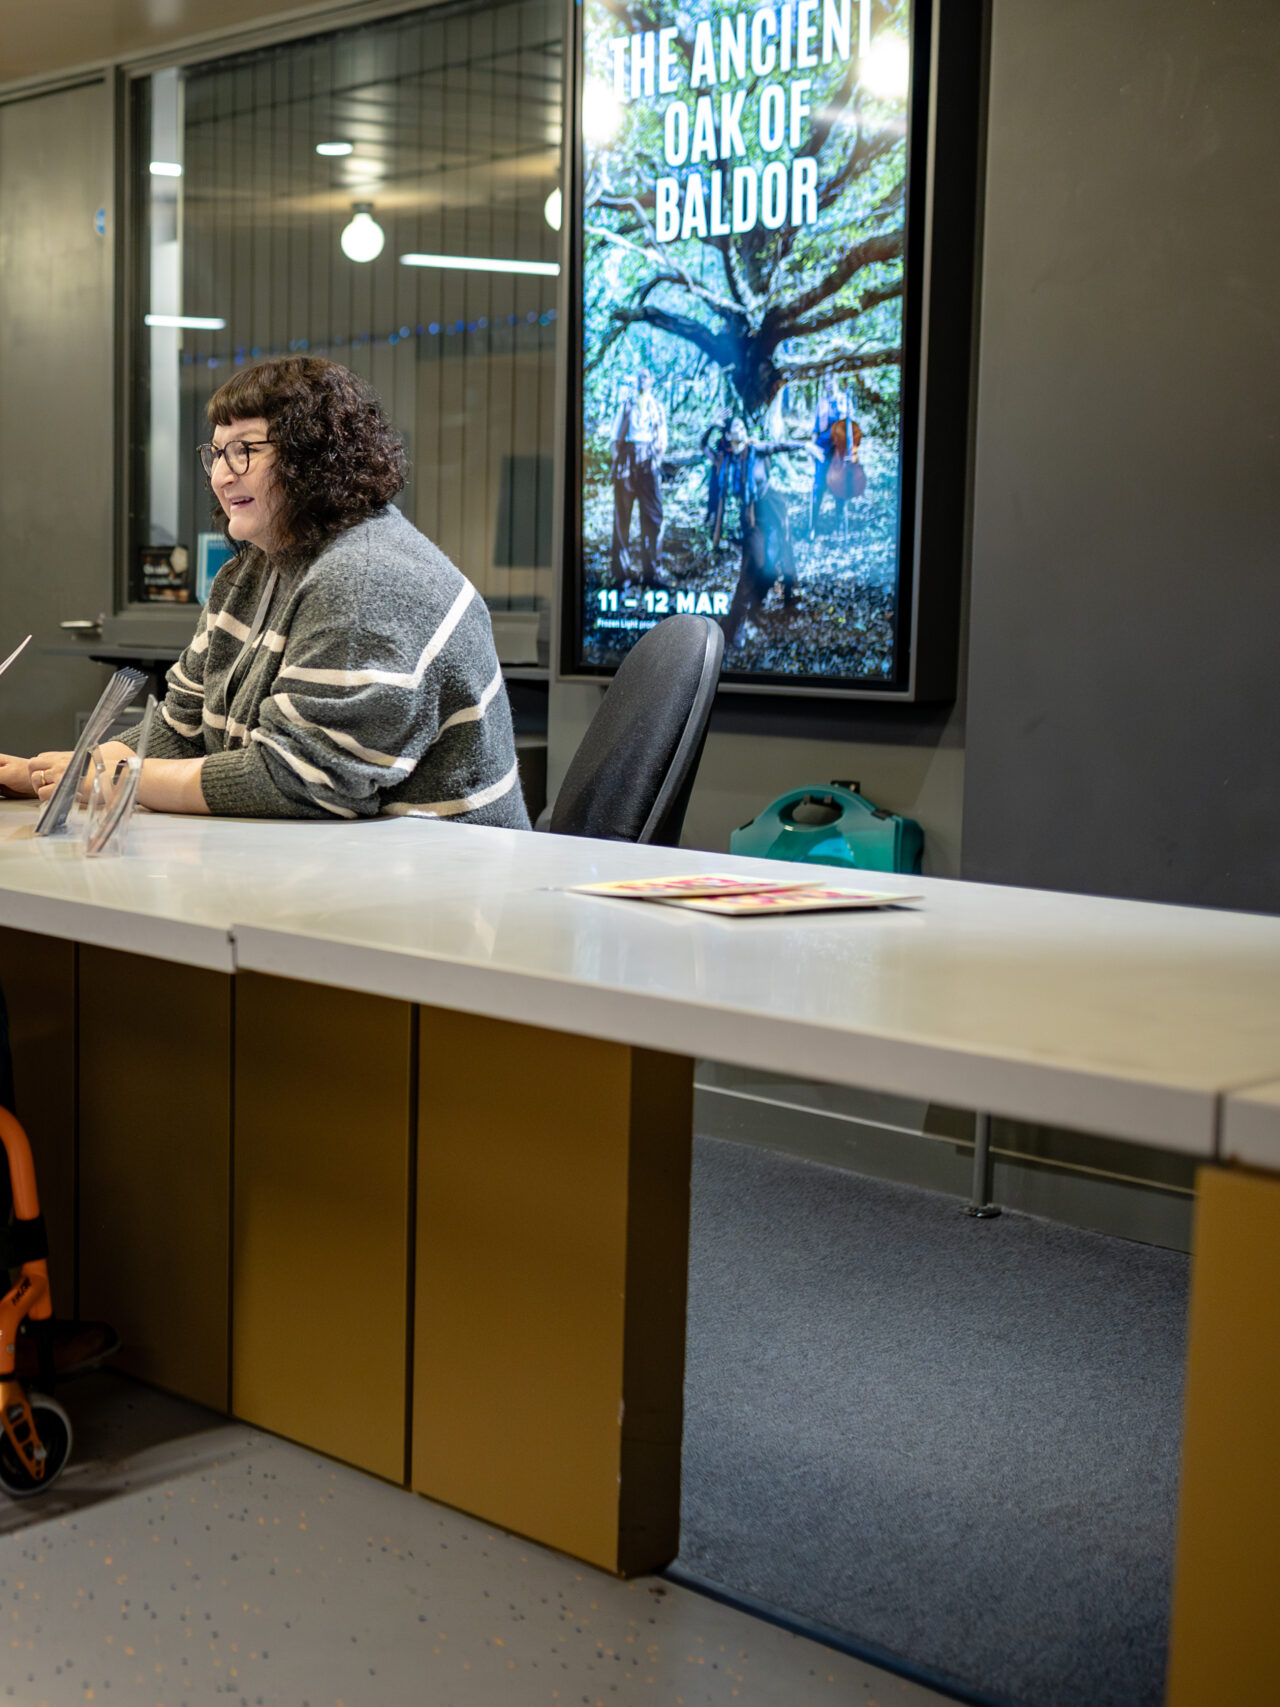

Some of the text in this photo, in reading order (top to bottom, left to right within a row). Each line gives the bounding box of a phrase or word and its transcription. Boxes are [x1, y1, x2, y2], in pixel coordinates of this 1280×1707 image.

[608, 0, 871, 101] THE ANCIENT
[664, 79, 811, 167] OAK OF
[655, 156, 818, 243] BALDOR
[597, 589, 618, 612] 11
[644, 590, 669, 613] 12
[676, 591, 729, 615] MAR
